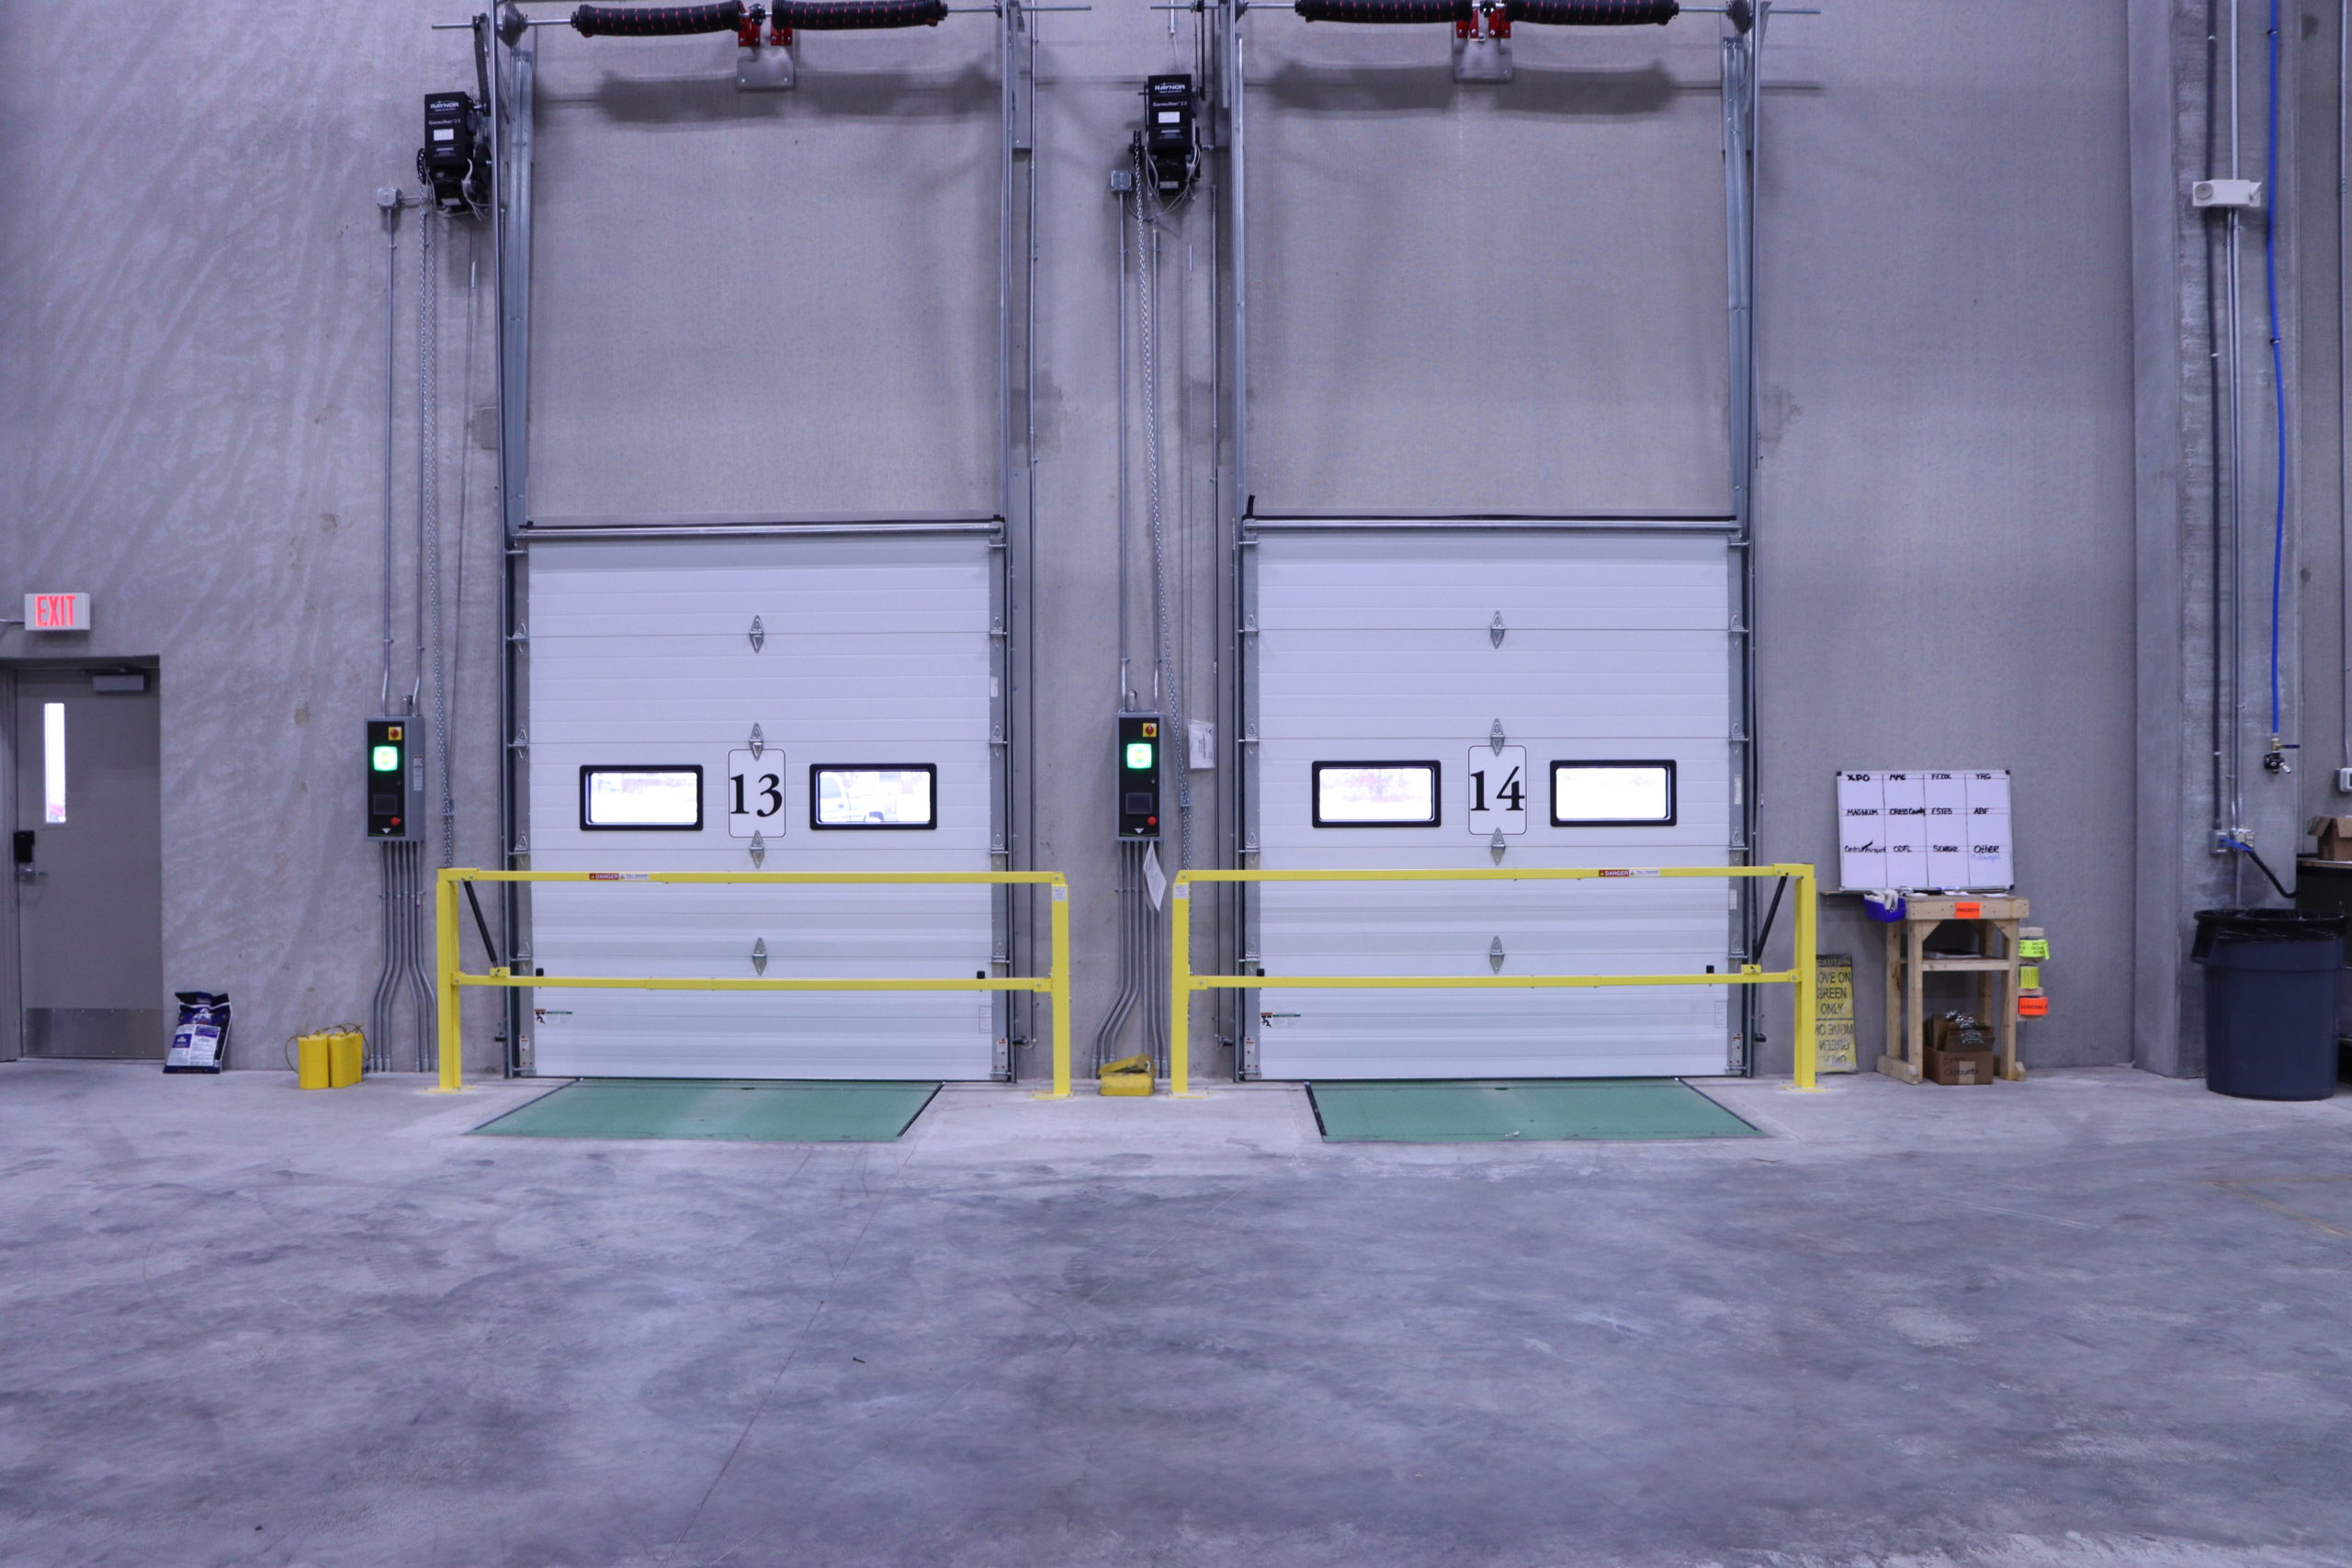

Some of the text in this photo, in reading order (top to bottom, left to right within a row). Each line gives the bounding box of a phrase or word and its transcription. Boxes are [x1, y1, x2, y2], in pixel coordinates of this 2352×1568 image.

[35, 594, 76, 627] EXIT
[1847, 773, 1871, 783] XPO
[1470, 765, 1525, 811] 14
[729, 773, 783, 818] 13
[1846, 808, 1880, 817] MAGNUM
[1889, 807, 1908, 816] CROSS
[1930, 807, 1953, 816] ESTES
[1973, 807, 1990, 816] ABF
[1893, 844, 1912, 853] ODFL
[1816, 971, 1851, 984] OVE ON
[1816, 987, 1847, 999] GREEN
[1820, 1003, 1844, 1015] ONLY
